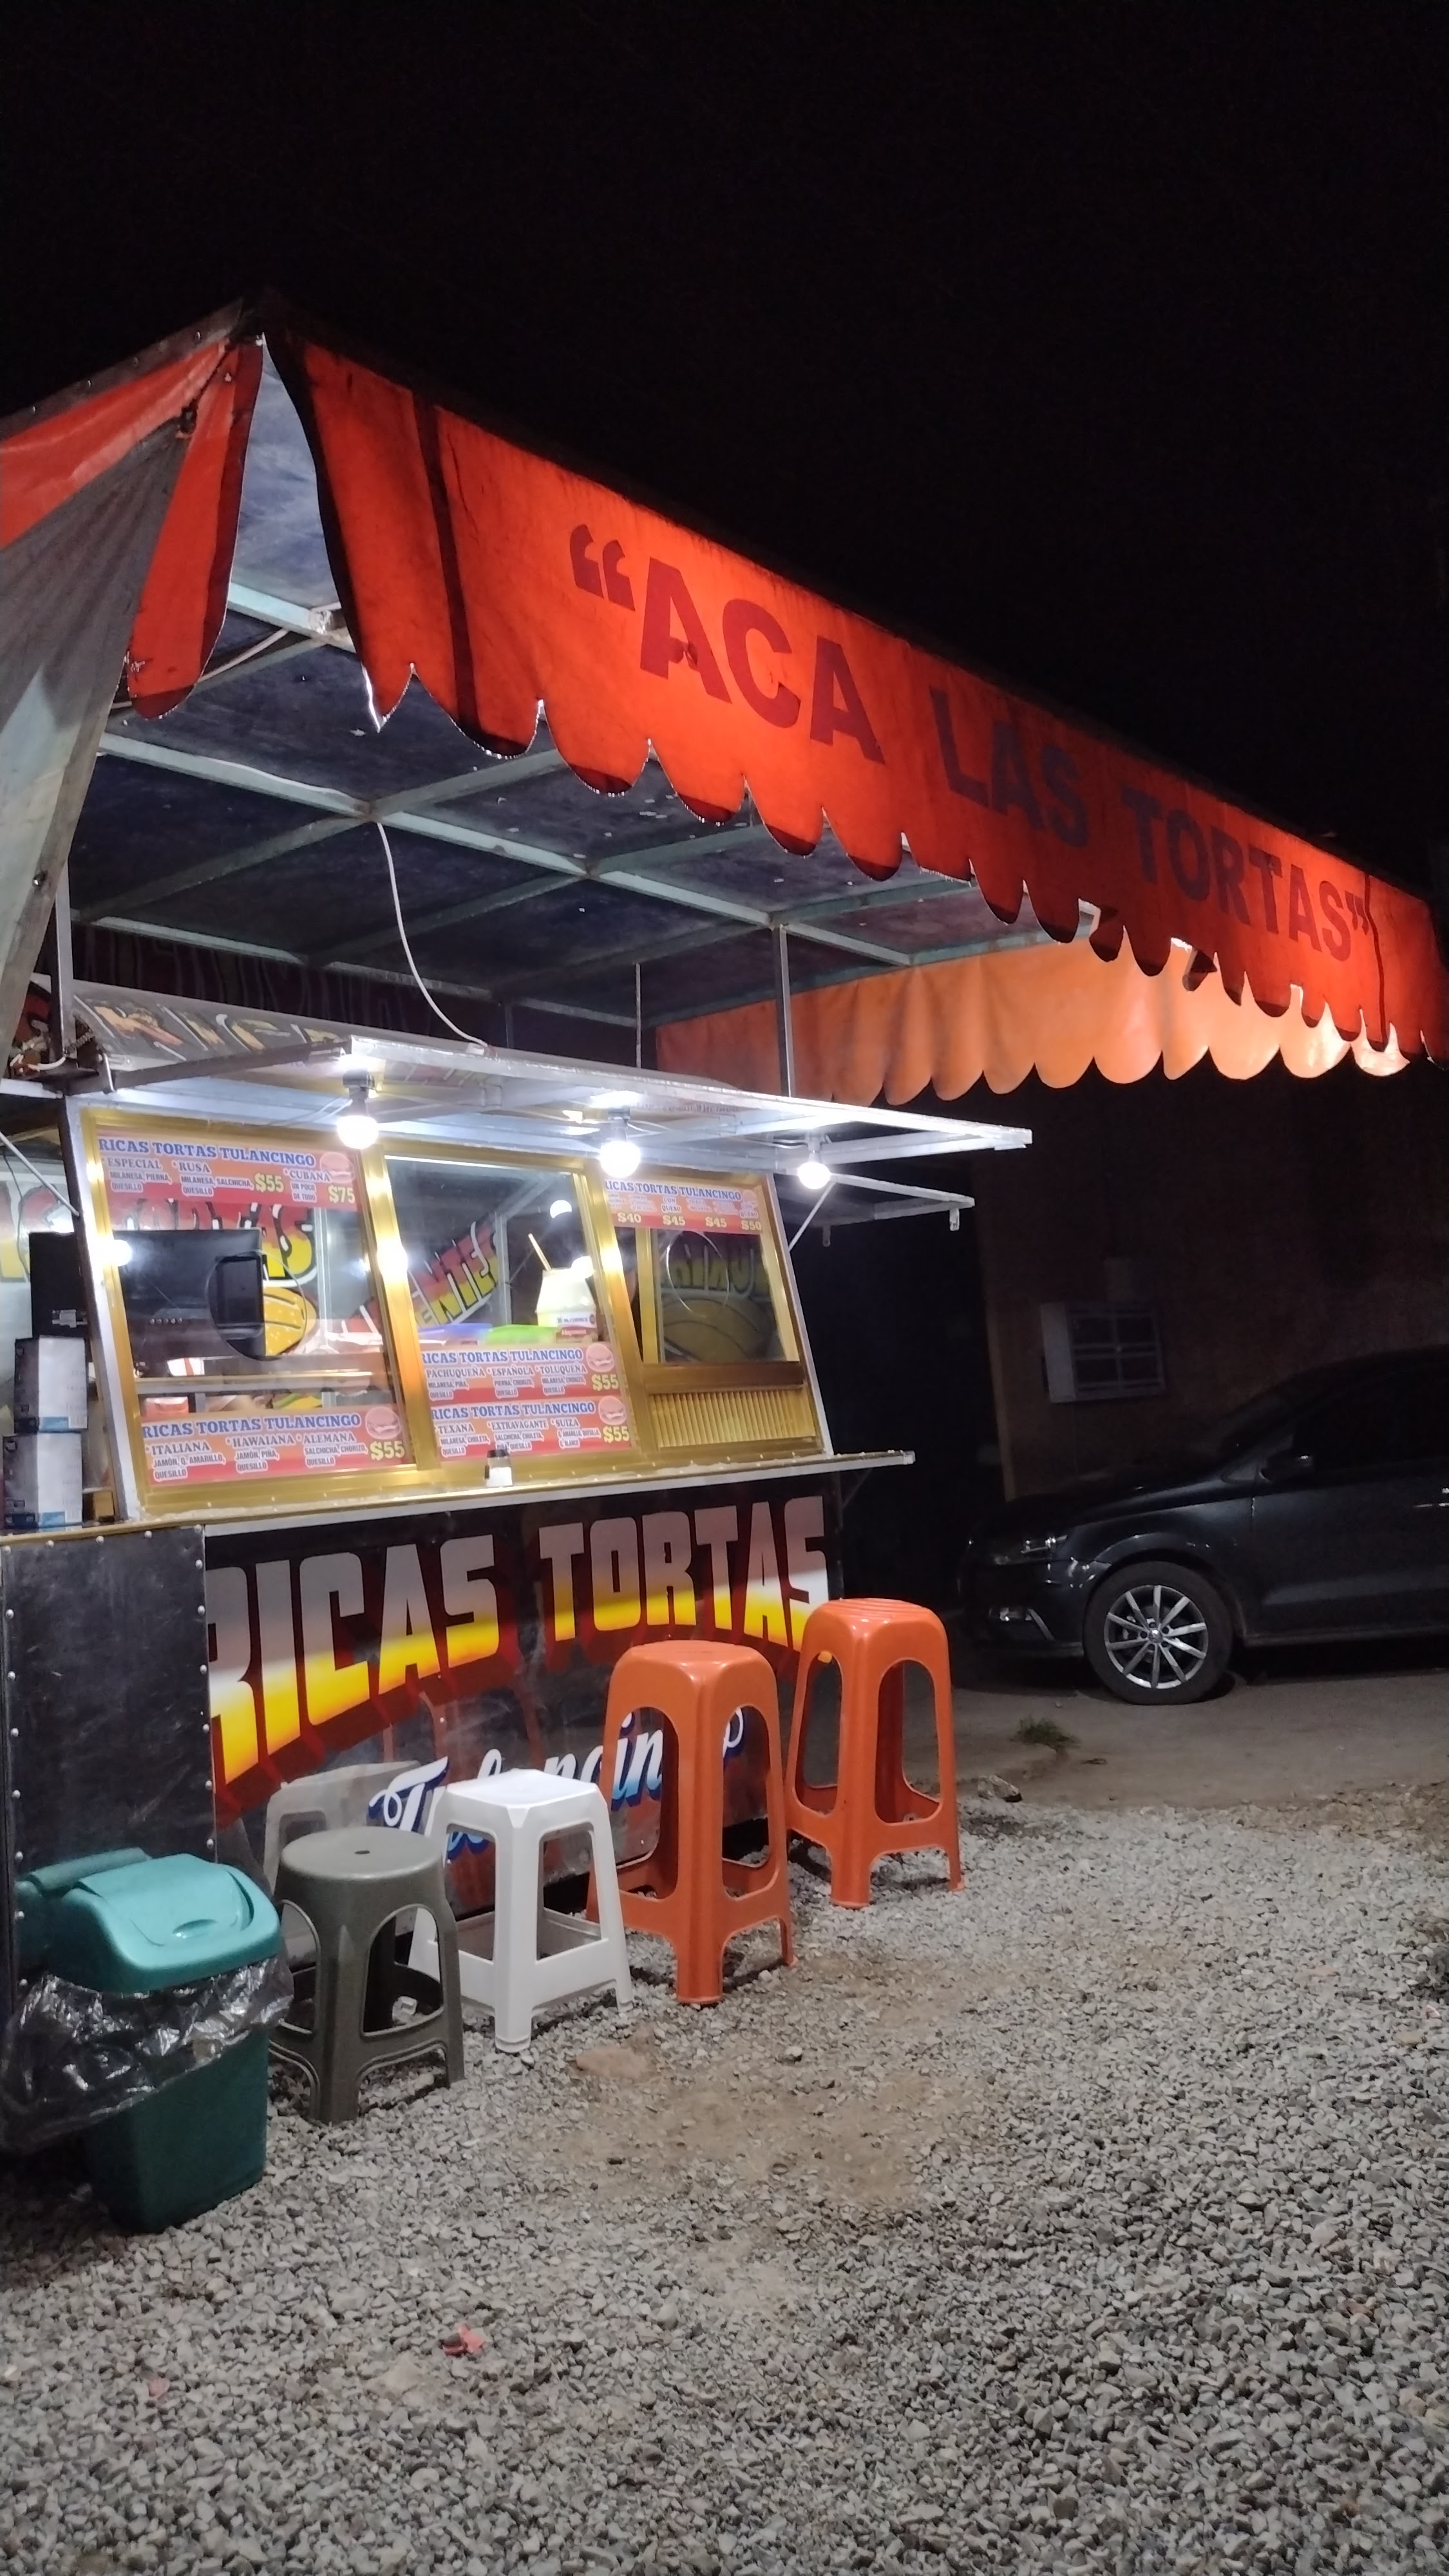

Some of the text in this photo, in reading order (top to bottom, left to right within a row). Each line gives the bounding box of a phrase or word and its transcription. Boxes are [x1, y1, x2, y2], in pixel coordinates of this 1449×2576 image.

[928, 685, 1091, 849] LAS
[99, 1139, 315, 1166] RICAS TORTAS TULANCINGO
[108, 1159, 161, 1169] ESPECIAL
[179, 1162, 210, 1173] RUSA
[290, 1170, 331, 1182] CUBANA
[112, 1182, 142, 1191] QUESILLO
[254, 1173, 284, 1193] $55
[182, 1186, 212, 1195] QUESILLO
[328, 1186, 355, 1204] $75
[636, 1183, 677, 1194] TORTAS
[679, 1188, 741, 1200] TULANCINGO
[301, 1193, 316, 1201] TODO
[618, 1213, 641, 1224] $40
[663, 1215, 685, 1226] $45
[705, 1217, 727, 1228] $45
[741, 1220, 761, 1231] $50
[459, 1351, 507, 1363] TORTAS
[510, 1349, 582, 1360] TULANCINGO
[427, 1367, 485, 1377] PACHUQUEÑA
[492, 1365, 533, 1376] ESPAÑOLA
[540, 1363, 586, 1374] TOLUQUEÑA
[592, 1374, 619, 1390] $55
[433, 1403, 595, 1419] RICAS TORTAS TULANCINGO
[142, 1414, 361, 1438] RICAS TORTAS TULANCINGO
[492, 1419, 548, 1430] EXTRAVAGANTE
[555, 1418, 579, 1427] SUIZA
[439, 1424, 474, 1434] TEXANA
[603, 1426, 630, 1443] $55
[232, 1435, 294, 1447] HAWAIANA
[303, 1433, 355, 1444] ALEMANA
[151, 1442, 209, 1455] ITALIANA
[370, 1441, 404, 1461] $55
[238, 1461, 267, 1471] QUESILLO
[306, 1457, 334, 1466] QUESILLO
[155, 1468, 186, 1479] QUESILLO
[205, 1495, 829, 1785] RICAS TORTAS
